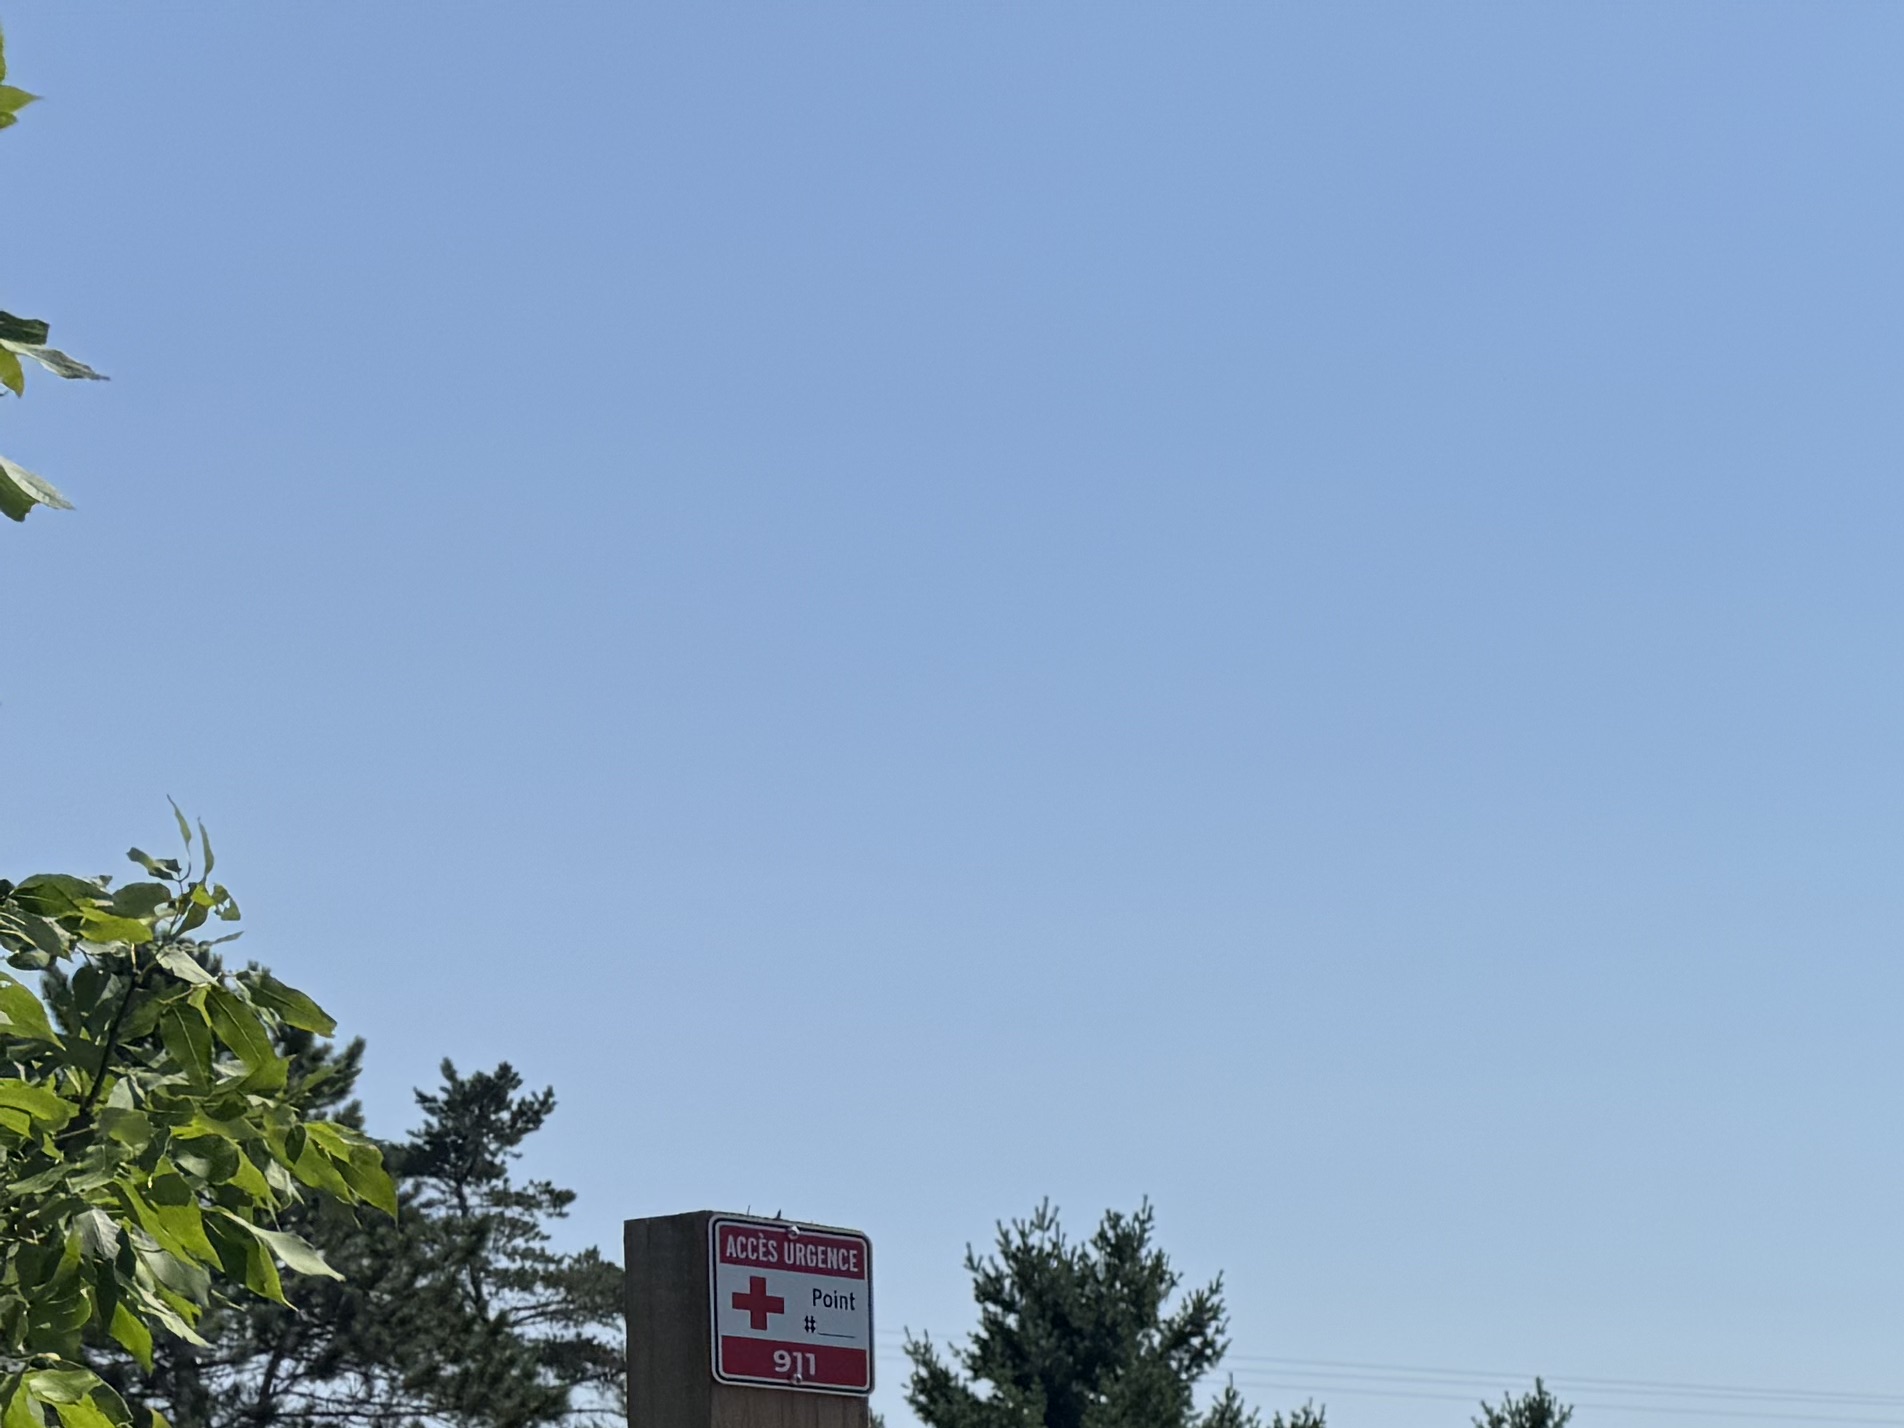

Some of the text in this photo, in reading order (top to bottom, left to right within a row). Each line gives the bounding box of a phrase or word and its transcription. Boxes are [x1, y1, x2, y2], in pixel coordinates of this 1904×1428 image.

[726, 1233, 858, 1272] ACCÈS URGENCE
[812, 1288, 856, 1311] Point
[773, 1350, 816, 1377] 911
